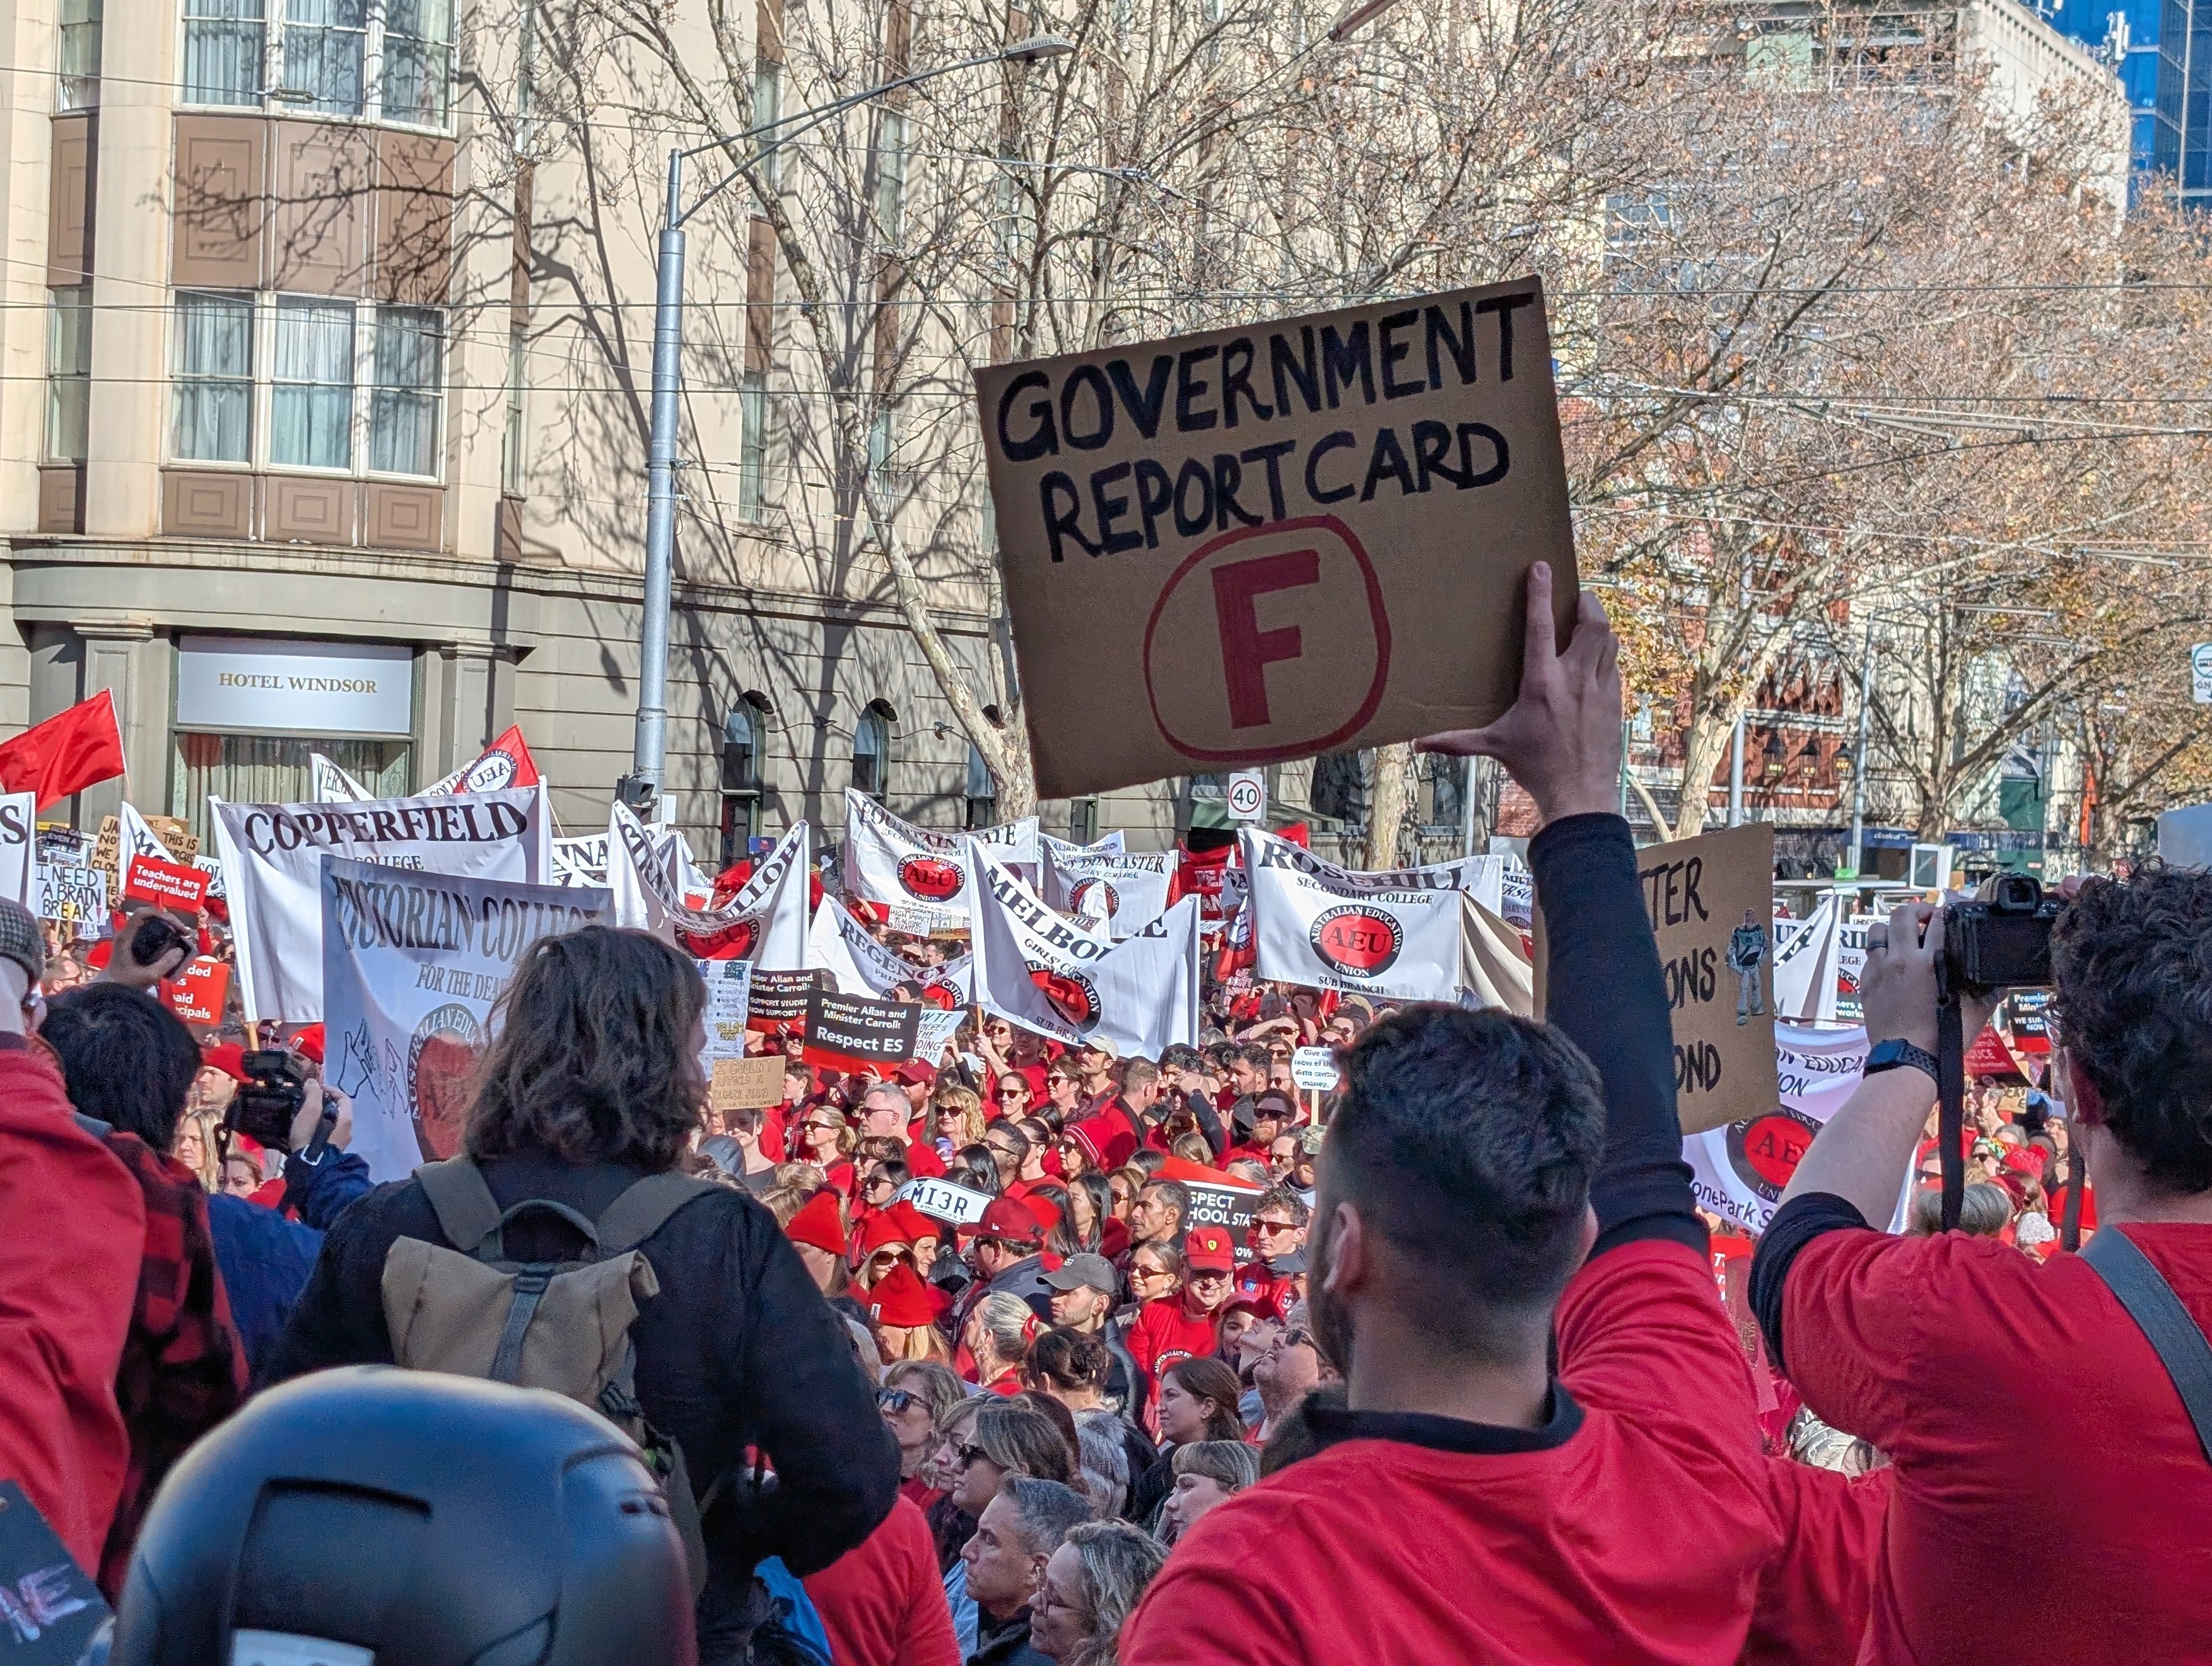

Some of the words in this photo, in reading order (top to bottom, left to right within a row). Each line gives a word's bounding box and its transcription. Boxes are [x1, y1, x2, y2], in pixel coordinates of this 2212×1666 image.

[998, 291, 1536, 462] GOVERNMENT
[1039, 438, 1296, 562] REPORT
[1304, 419, 1511, 504] CARD
[1211, 549, 1321, 729] F
[219, 672, 284, 689] HOTEL
[287, 676, 378, 694] WINDSOR
[1234, 787, 1258, 805] 40
[243, 801, 527, 856] COPPERFIELD
[981, 824, 1017, 847] ATE
[163, 832, 185, 847] THIS
[186, 838, 198, 851] IS
[36, 863, 49, 881] I
[52, 865, 98, 887] NEED
[1079, 854, 1166, 875] DONCASTER
[1258, 838, 1470, 892] ROSEHILL
[136, 864, 182, 885] Teachers
[182, 878, 201, 890] are
[904, 868, 953, 887] AEU
[41, 882, 54, 899] A
[57, 883, 102, 906] BRAIN
[133, 877, 199, 901] undervalued
[913, 892, 940, 902] UNION
[1296, 875, 1376, 902] SECONDARY
[1377, 892, 1434, 905] COLLEGE
[1311, 905, 1363, 945] AUSTRALIAN
[1365, 907, 1403, 954] EDUCATION
[1325, 926, 1390, 955] AEU
[839, 916, 951, 982] REGENCY
[186, 964, 212, 977] ded
[770, 974, 794, 983] Allan
[795, 973, 814, 982] and
[1334, 960, 1370, 977] UNION
[415, 964, 444, 993] FOR
[447, 968, 474, 998] THE
[1318, 975, 1338, 987] SUB
[1339, 979, 1384, 995] BRANCH
[821, 998, 860, 1015] Premier
[860, 1005, 886, 1018] Allan
[887, 1009, 907, 1020] and
[823, 1010, 863, 1027] Minister
[1035, 1015, 1055, 1030] SUB
[816, 1025, 879, 1052] Respect
[883, 1037, 904, 1053] ES
[915, 1038, 942, 1051] DING
[1800, 1053, 1867, 1074] EDUCA
[1753, 1130, 1806, 1168] AE
[1758, 1182, 1782, 1202] UNI
[1757, 1208, 1774, 1229] S
